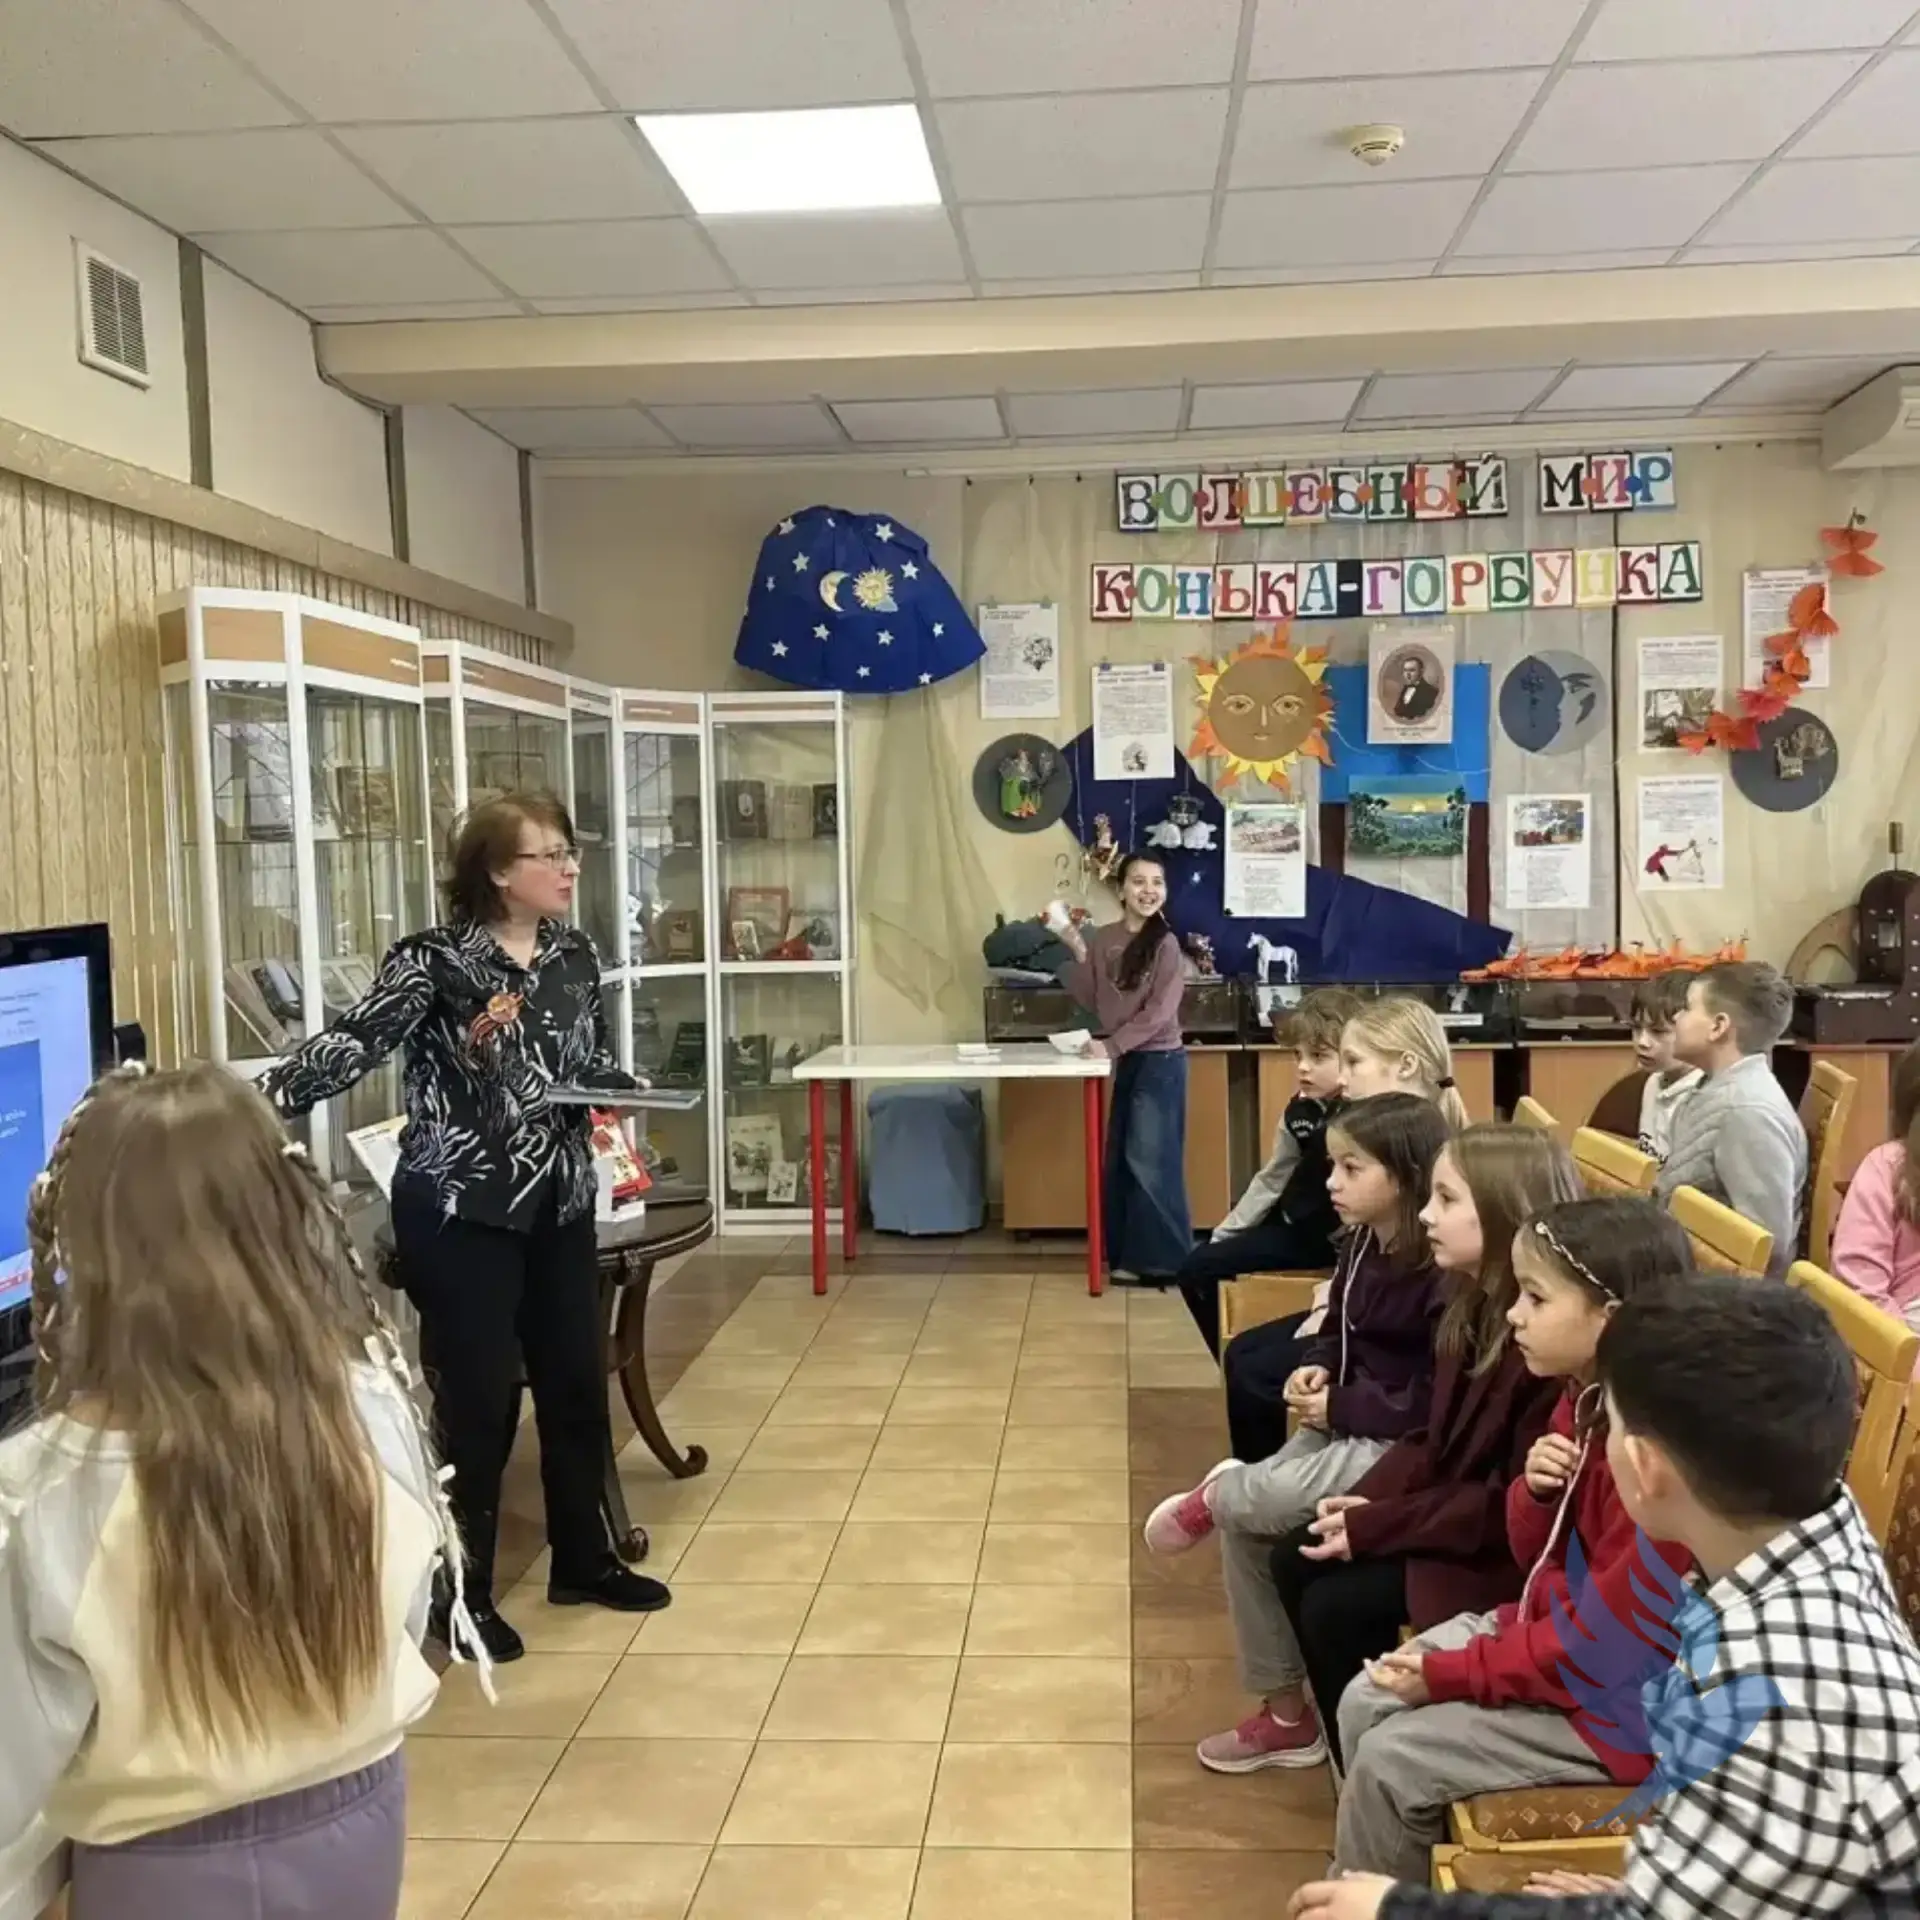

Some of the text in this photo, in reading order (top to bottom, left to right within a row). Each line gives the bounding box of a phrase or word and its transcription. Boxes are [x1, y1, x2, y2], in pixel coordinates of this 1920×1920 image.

[1121, 452, 1672, 526] ВОЛШЕБНЫЙ МИР
[1095, 545, 1701, 616] КОНЬКА-ГОРБУНКА
